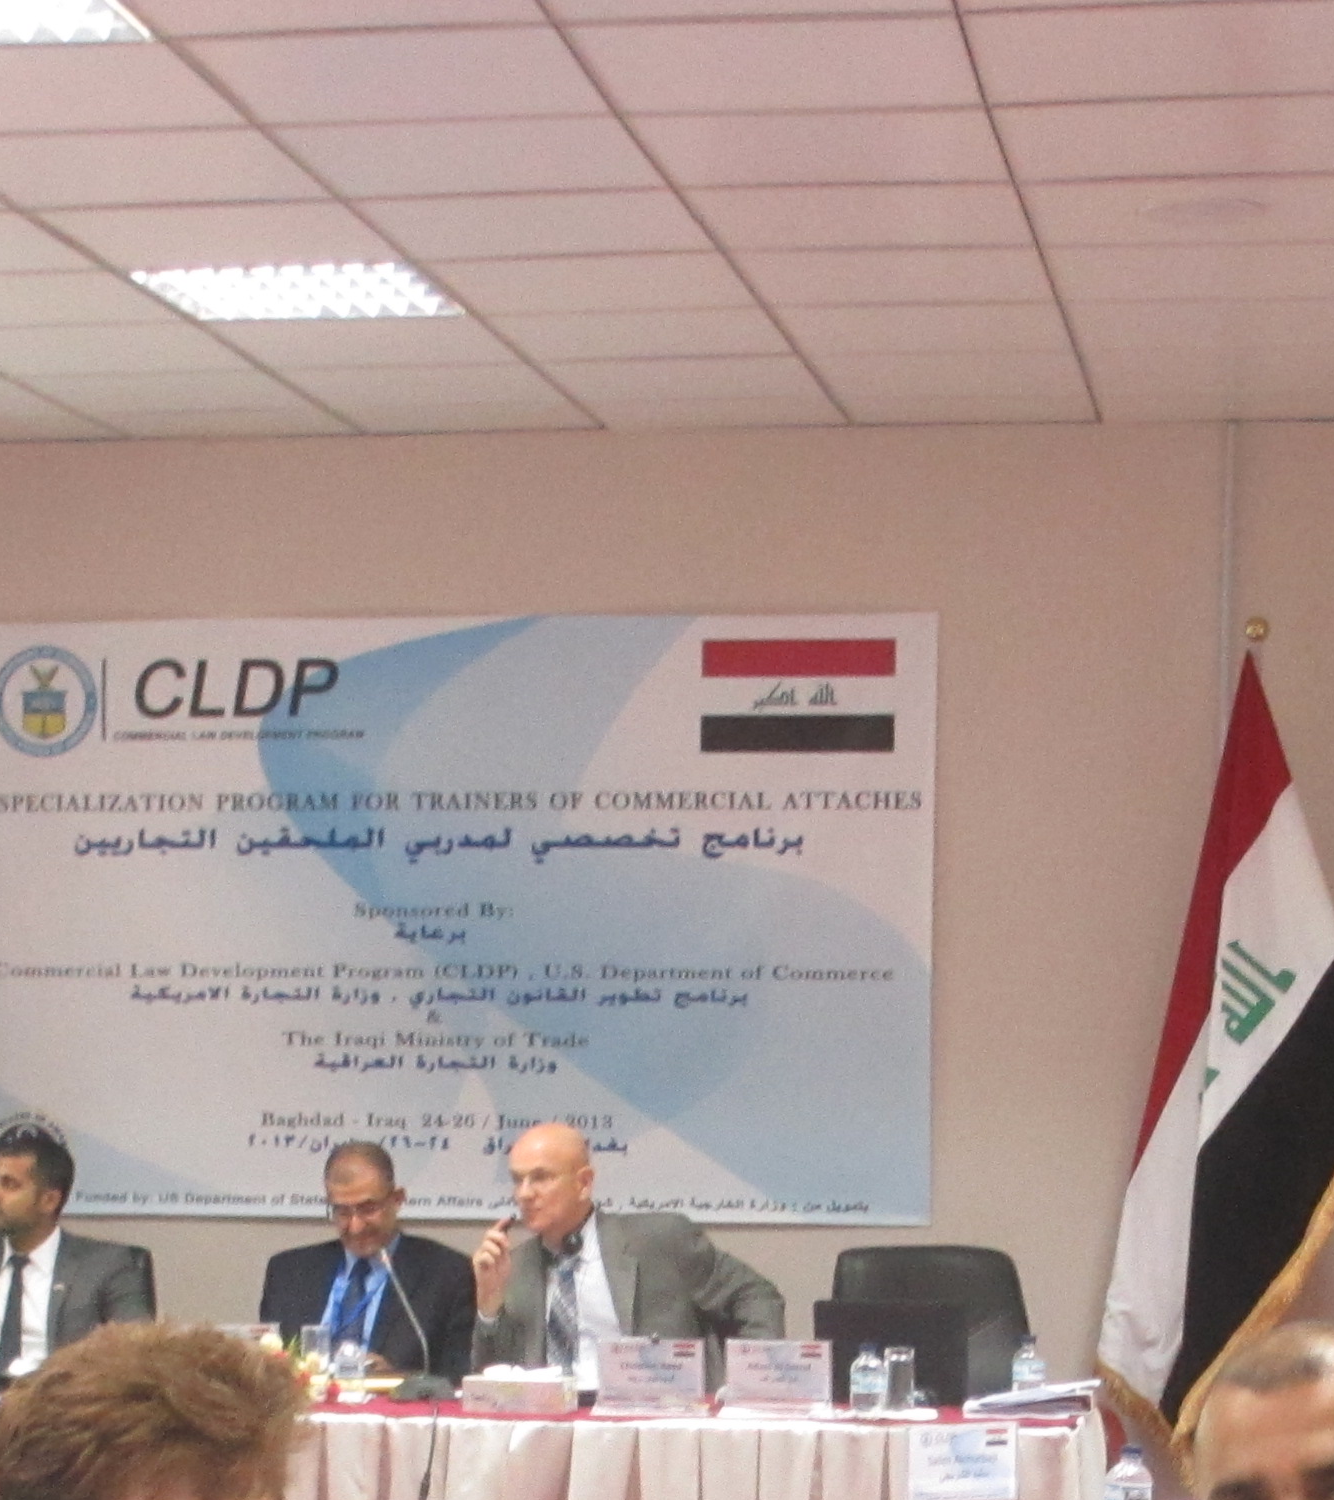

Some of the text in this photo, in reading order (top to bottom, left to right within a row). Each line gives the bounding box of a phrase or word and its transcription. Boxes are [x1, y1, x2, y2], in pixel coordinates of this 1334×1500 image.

[134, 657, 339, 719] CLDP
[113, 729, 187, 741] COMMERCIAL
[221, 730, 303, 741] DEVELOPMENT
[305, 730, 366, 741] PROGRAM
[216, 792, 339, 813] PROGRAM
[351, 791, 399, 812] FOR
[411, 791, 539, 812] TRAINERS
[549, 791, 582, 812] OF
[593, 791, 771, 811] COMMERCIAL
[782, 791, 923, 811] ATTACHES
[74, 826, 804, 865] برنامج تخصصي لمدربي الملحقين التجاريين
[353, 902, 515, 920] Sponsored By:
[394, 921, 467, 944] برعاية
[130, 963, 171, 979] Law
[179, 962, 325, 983] Development
[332, 963, 425, 983] Program
[431, 963, 519, 982] (CLDP)
[544, 965, 591, 980] U.S.
[599, 965, 733, 984] Department
[740, 964, 764, 981] of
[771, 964, 895, 982] Commerce
[240, 985, 321, 1005] التجارة
[331, 984, 380, 1006] وزارة
[408, 986, 496, 1009] التجاري
[506, 987, 587, 1005] القانون
[596, 987, 662, 1006] تطوير
[673, 987, 748, 1009] برنامج
[426, 1009, 442, 1025] &
[281, 1031, 589, 1050] The Iraqi Ministry of Trade
[314, 1053, 558, 1075] وزارة التجارة العراقية
[261, 1112, 345, 1129] Baghdad
[366, 1112, 407, 1130] Iraq
[421, 1112, 476, 1129] 24-26
[75, 1191, 127, 1204] Funded
[157, 1192, 179, 1205] US
[185, 1191, 267, 1207] Department
[270, 1193, 285, 1206] of
[436, 1196, 483, 1208] Affairs
